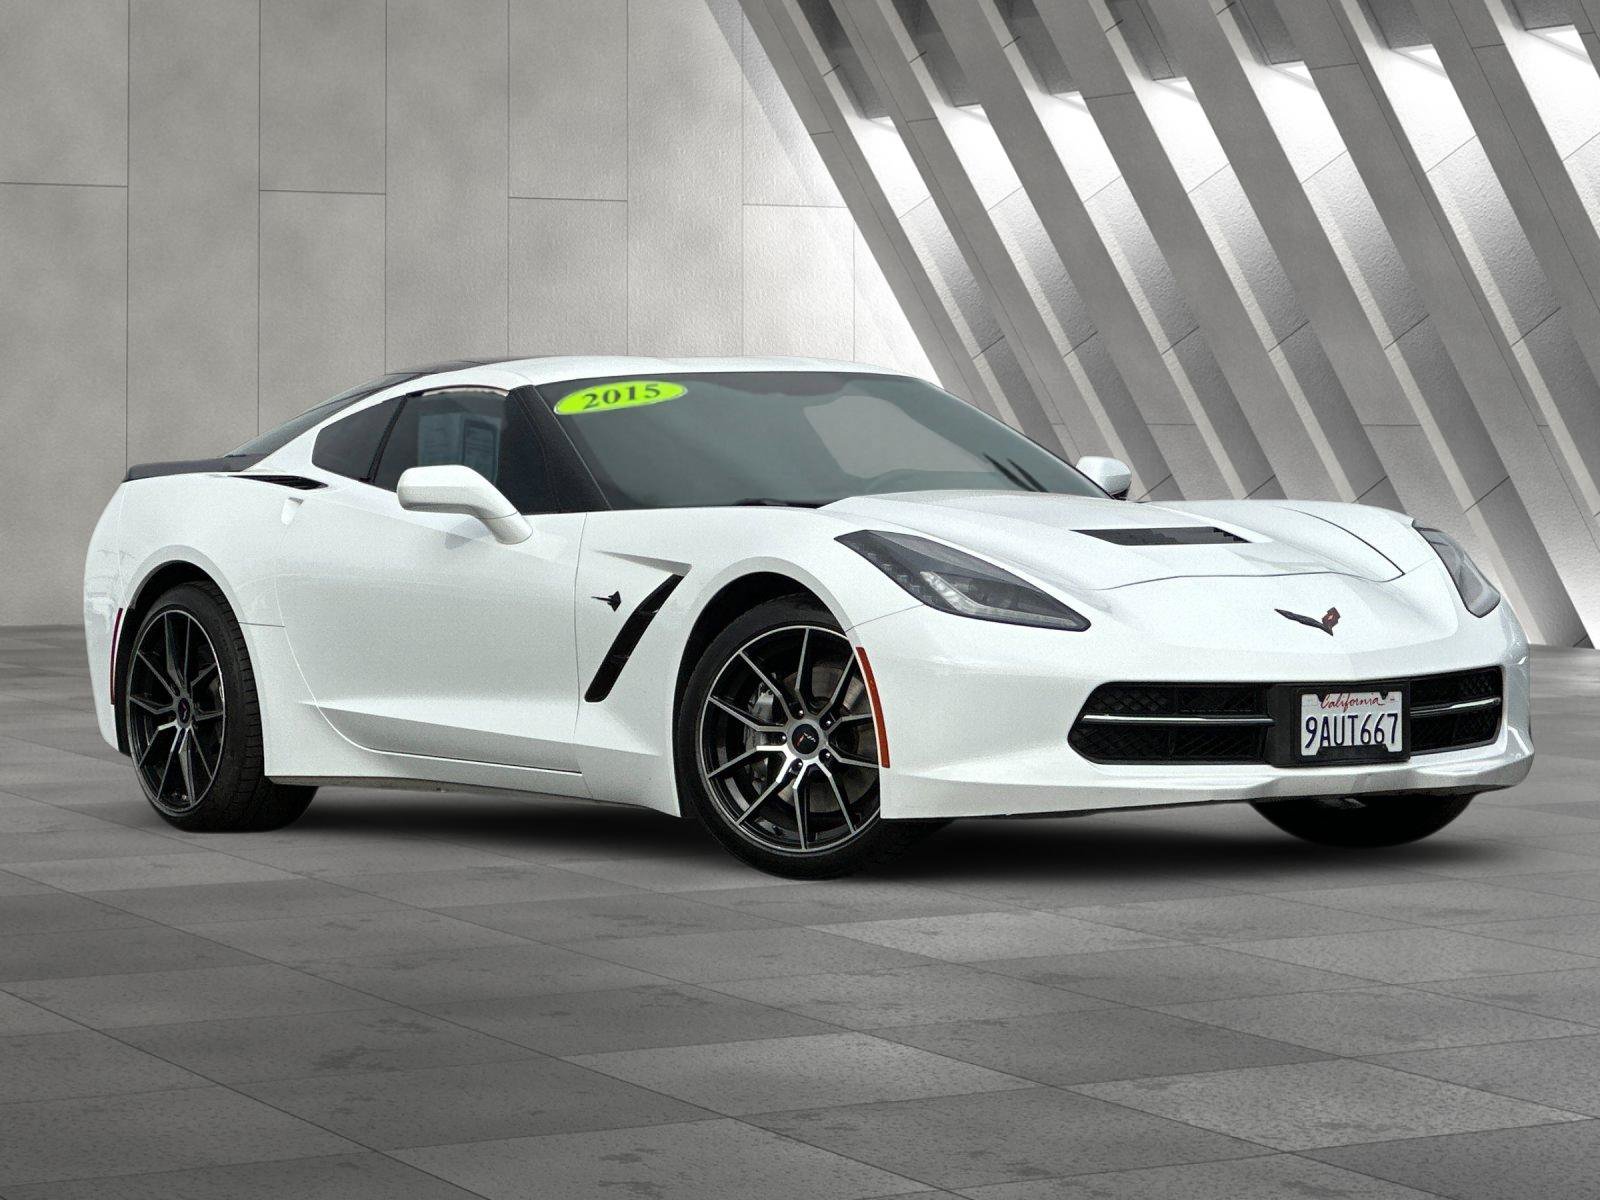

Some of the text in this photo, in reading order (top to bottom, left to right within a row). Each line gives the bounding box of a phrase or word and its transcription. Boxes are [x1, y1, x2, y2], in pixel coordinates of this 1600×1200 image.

[582, 384, 661, 409] 2015
[1320, 691, 1384, 712] California
[1304, 713, 1399, 749] 9AUT667
